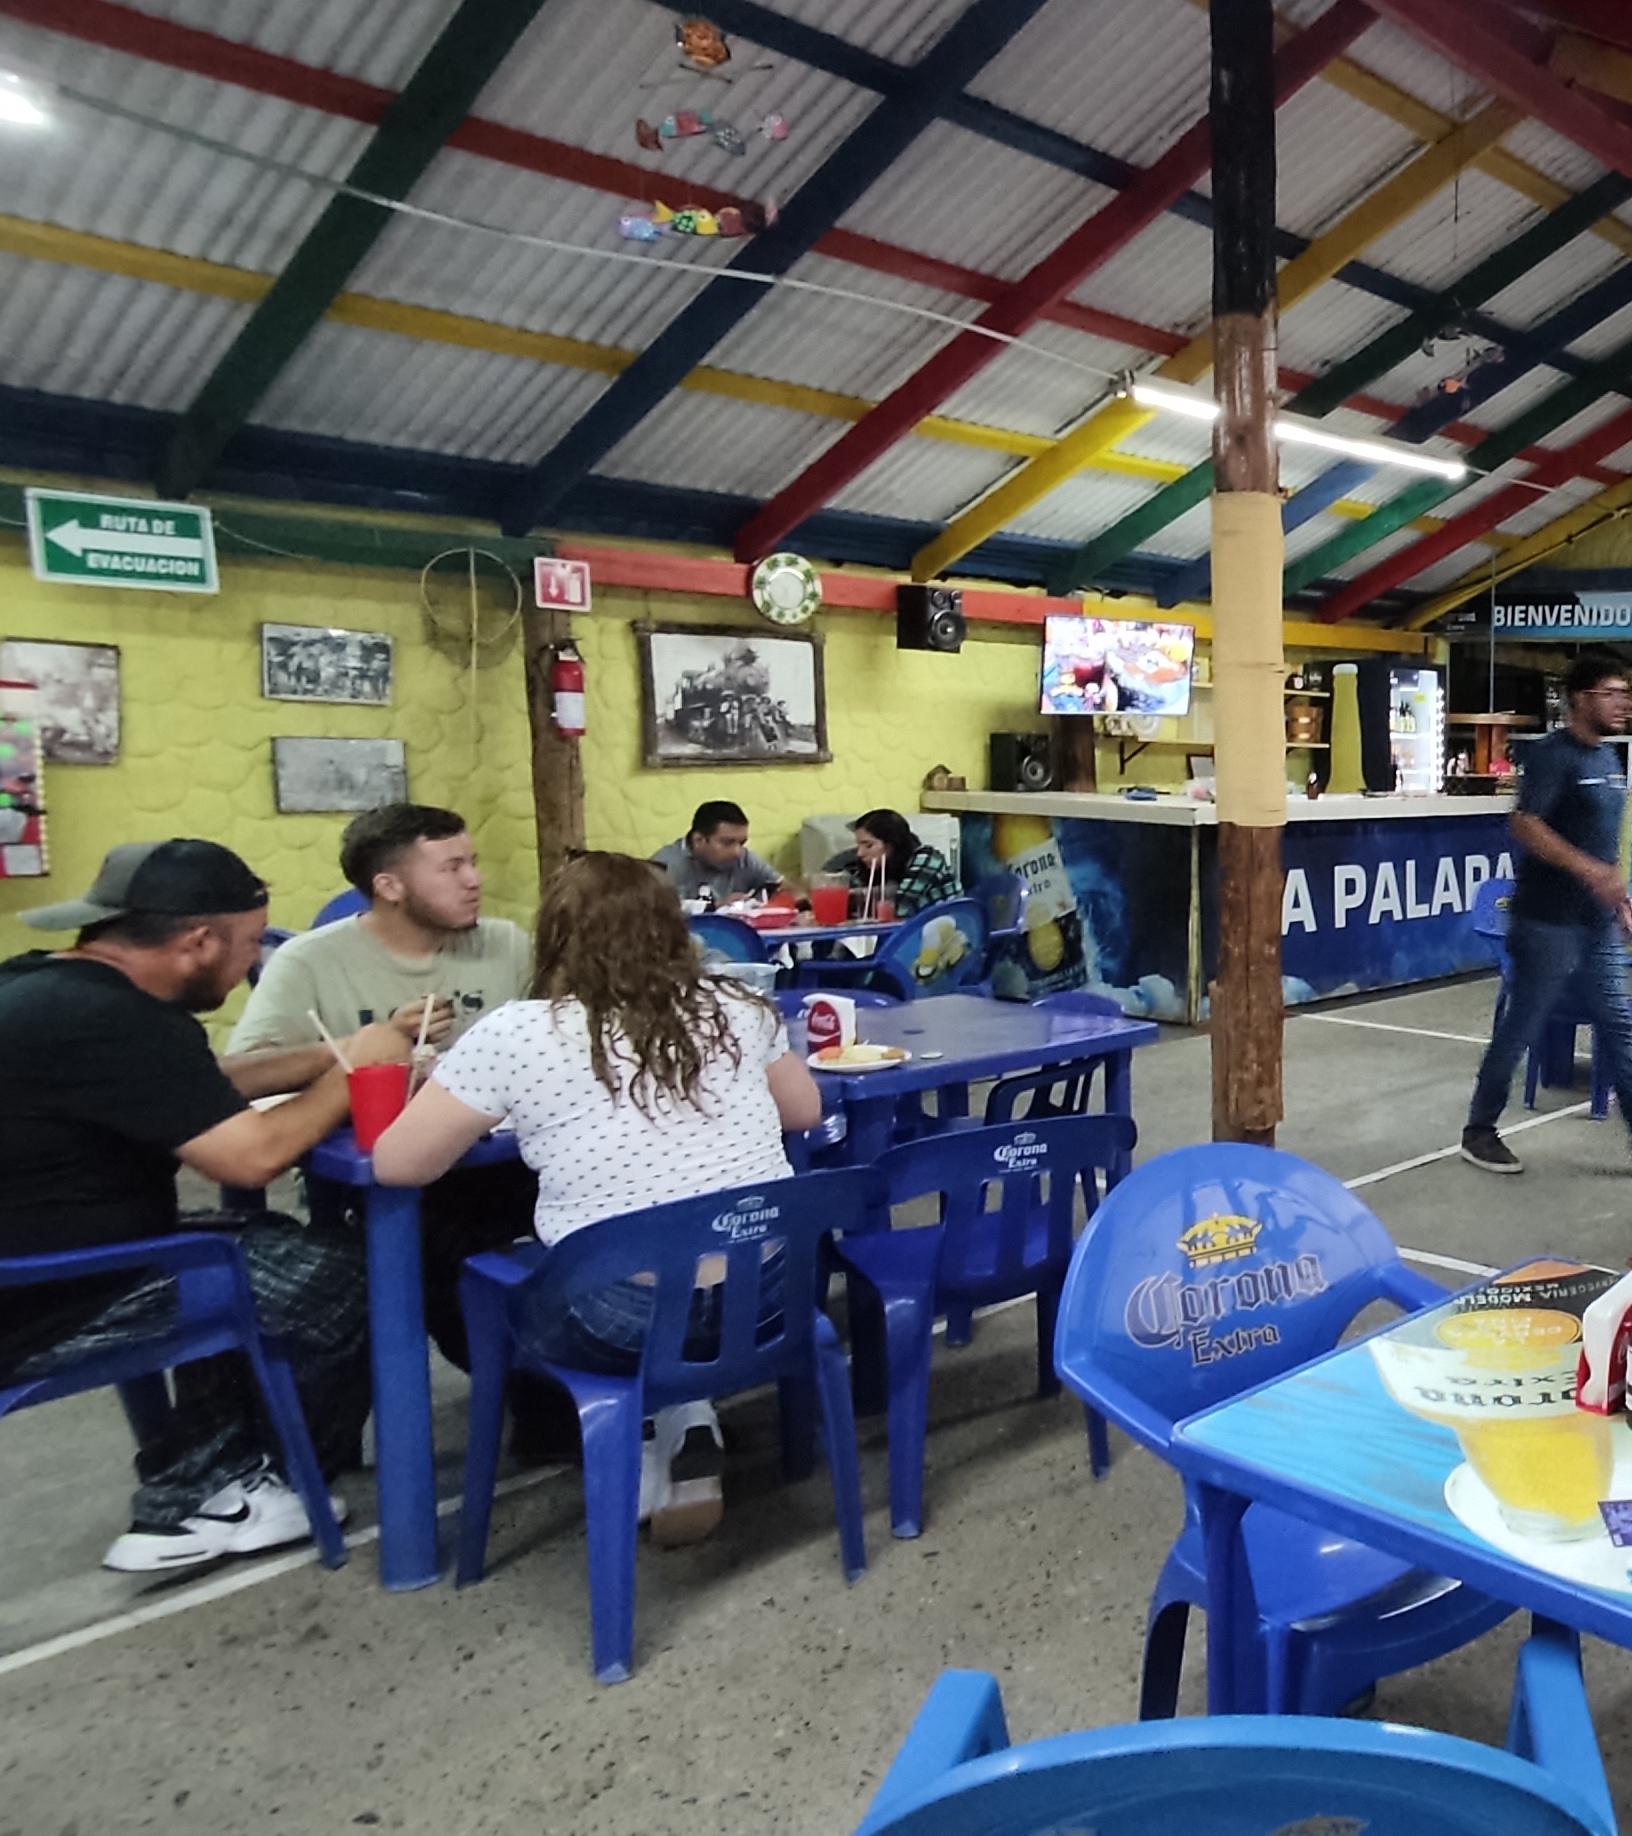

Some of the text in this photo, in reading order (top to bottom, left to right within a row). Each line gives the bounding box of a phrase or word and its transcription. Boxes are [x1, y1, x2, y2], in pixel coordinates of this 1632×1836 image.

[100, 514, 176, 536] RUTA DE
[86, 552, 200, 577] EVACUACION
[993, 1143, 1048, 1162] Corona
[711, 1206, 779, 1233] Corona
[1124, 1253, 1329, 1349] Corona
[1188, 1323, 1281, 1368] Extra
